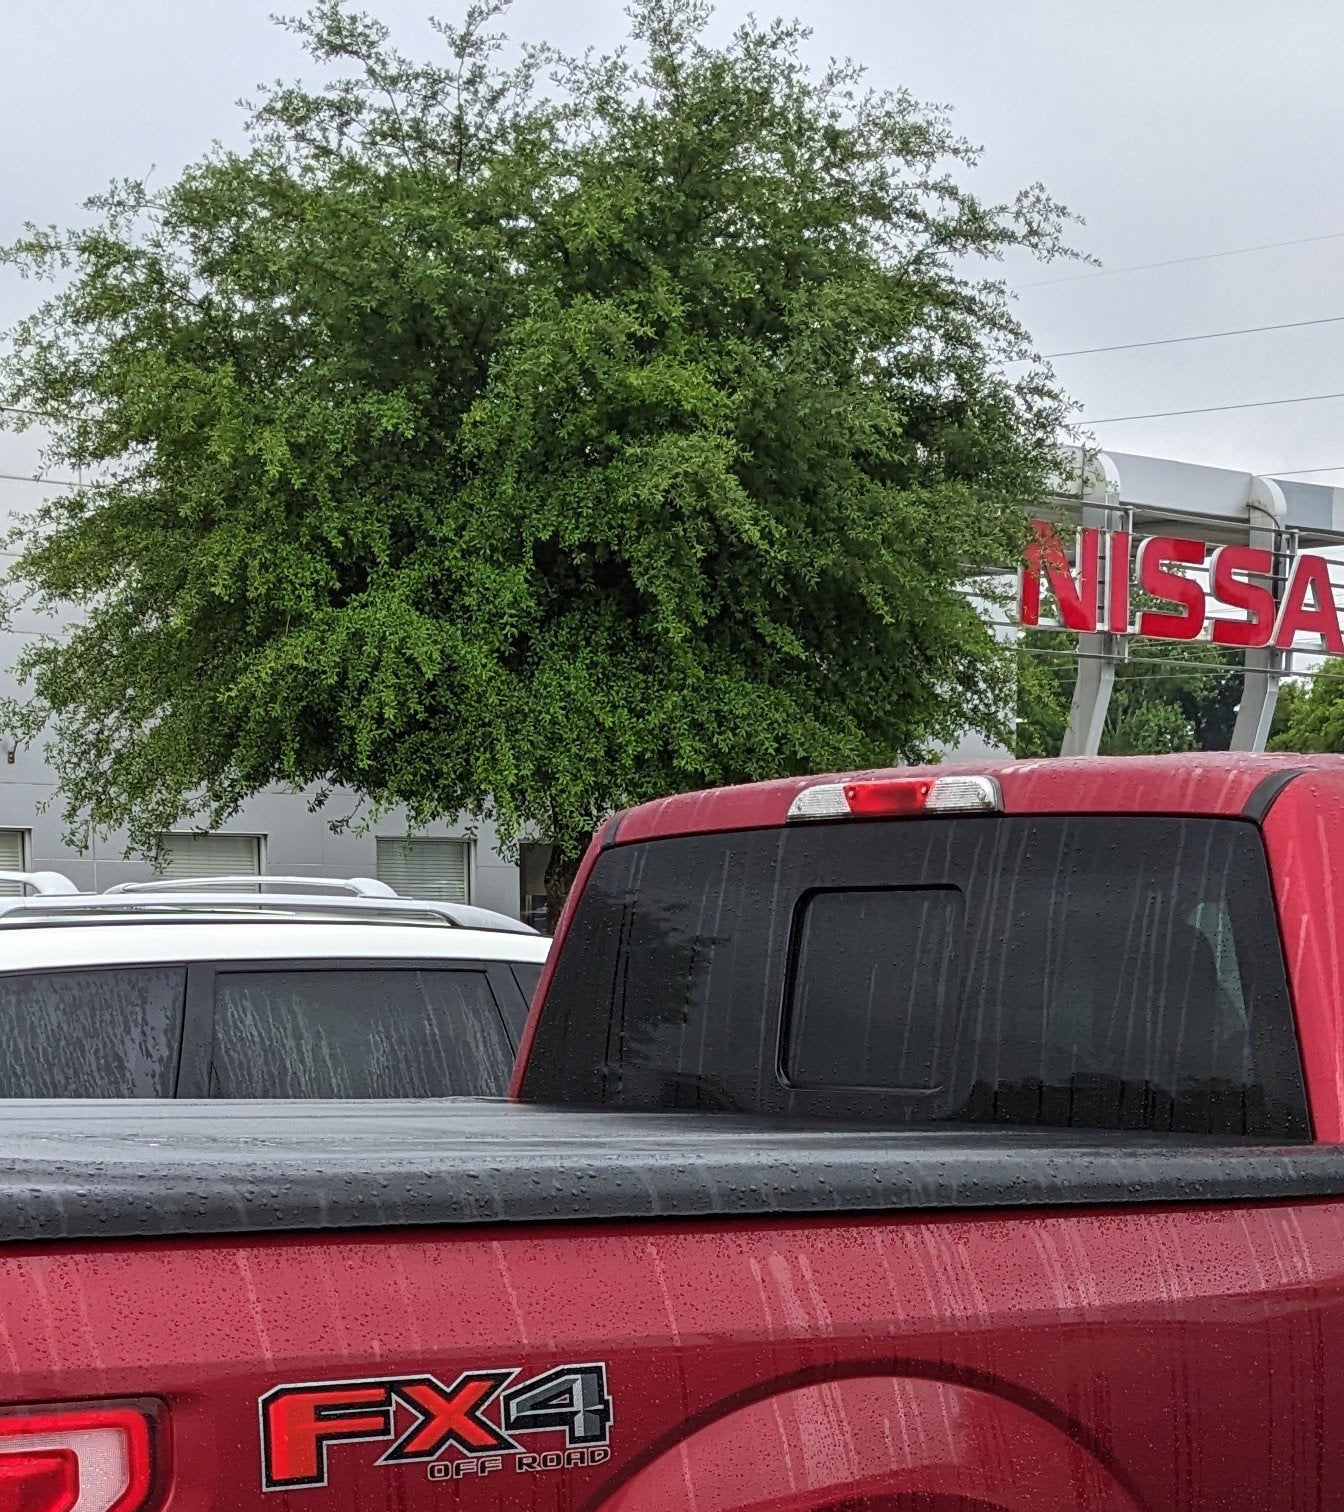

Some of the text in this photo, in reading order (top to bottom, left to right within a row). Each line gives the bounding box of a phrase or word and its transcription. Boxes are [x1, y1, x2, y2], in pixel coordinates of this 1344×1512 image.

[258, 1362, 614, 1493] FX4
[427, 1446, 612, 1481] OFF ROAD
